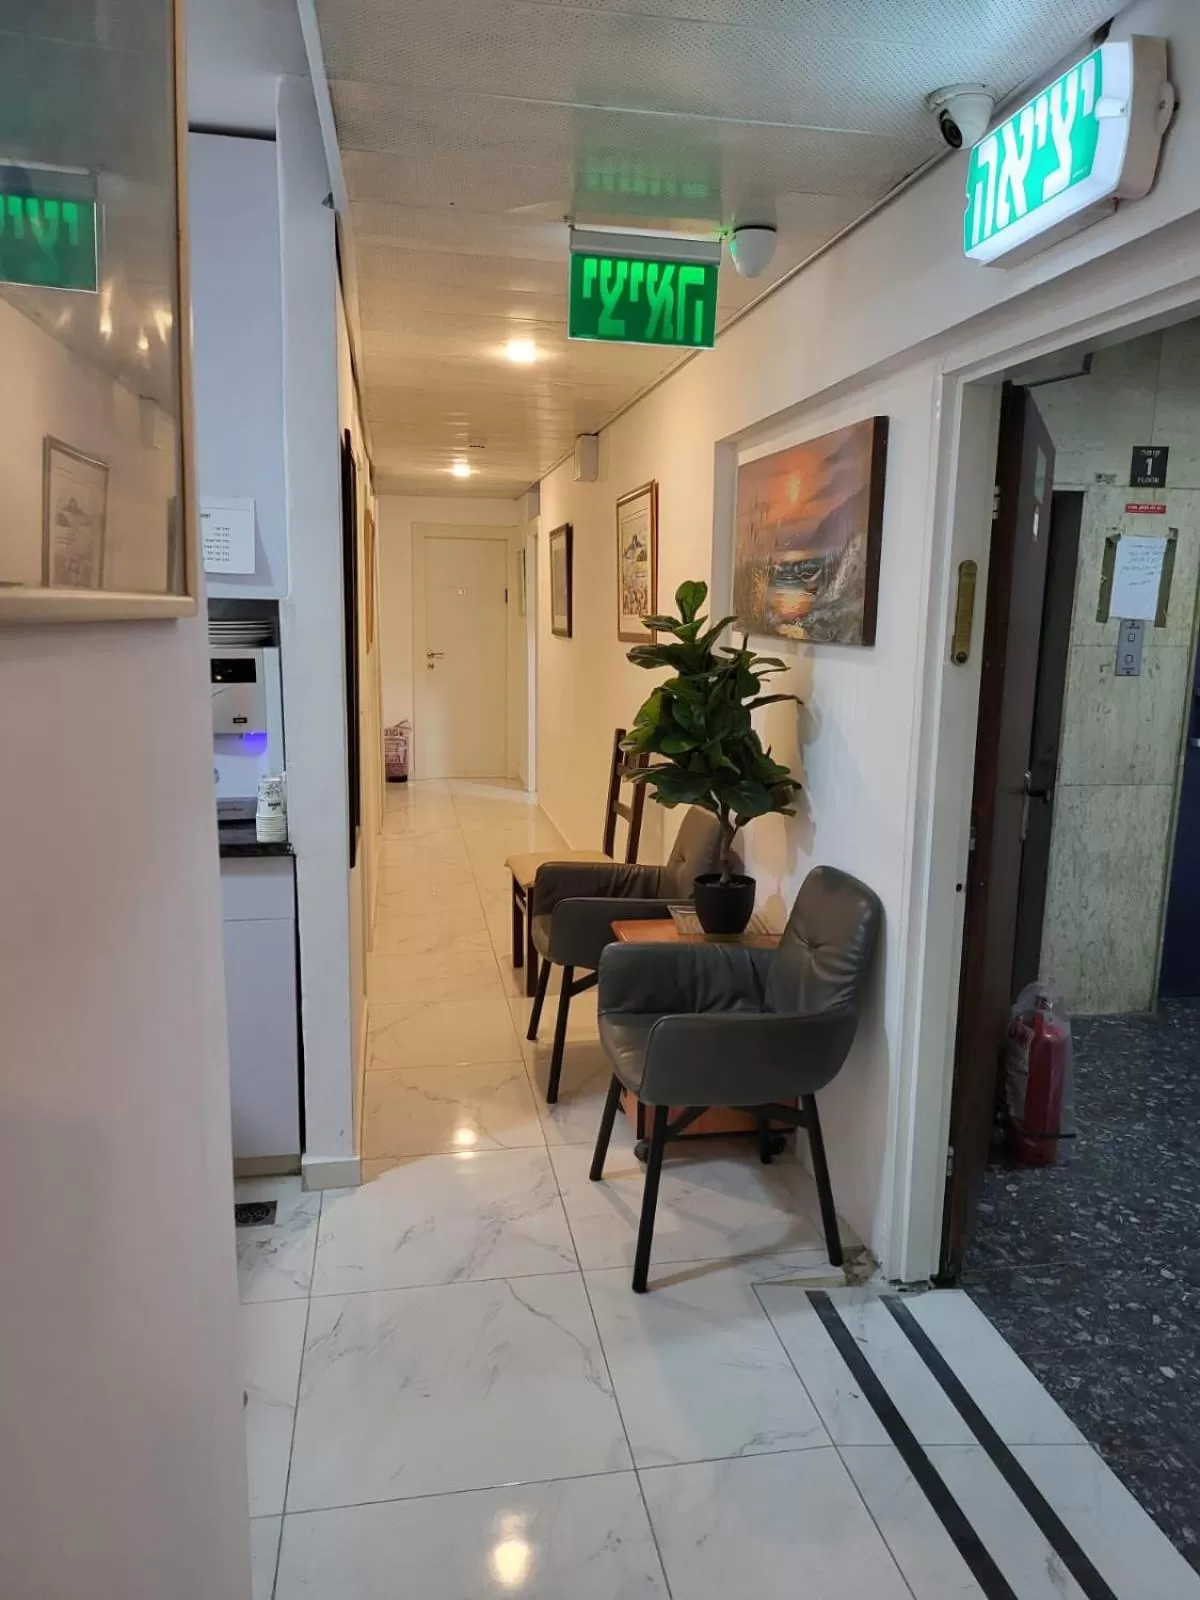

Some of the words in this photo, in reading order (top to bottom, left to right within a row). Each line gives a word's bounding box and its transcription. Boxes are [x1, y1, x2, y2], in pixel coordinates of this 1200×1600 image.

[971, 57, 1096, 247] יציאה
[1145, 457, 1153, 476] 1
[1137, 476, 1160, 485] FLOOR
